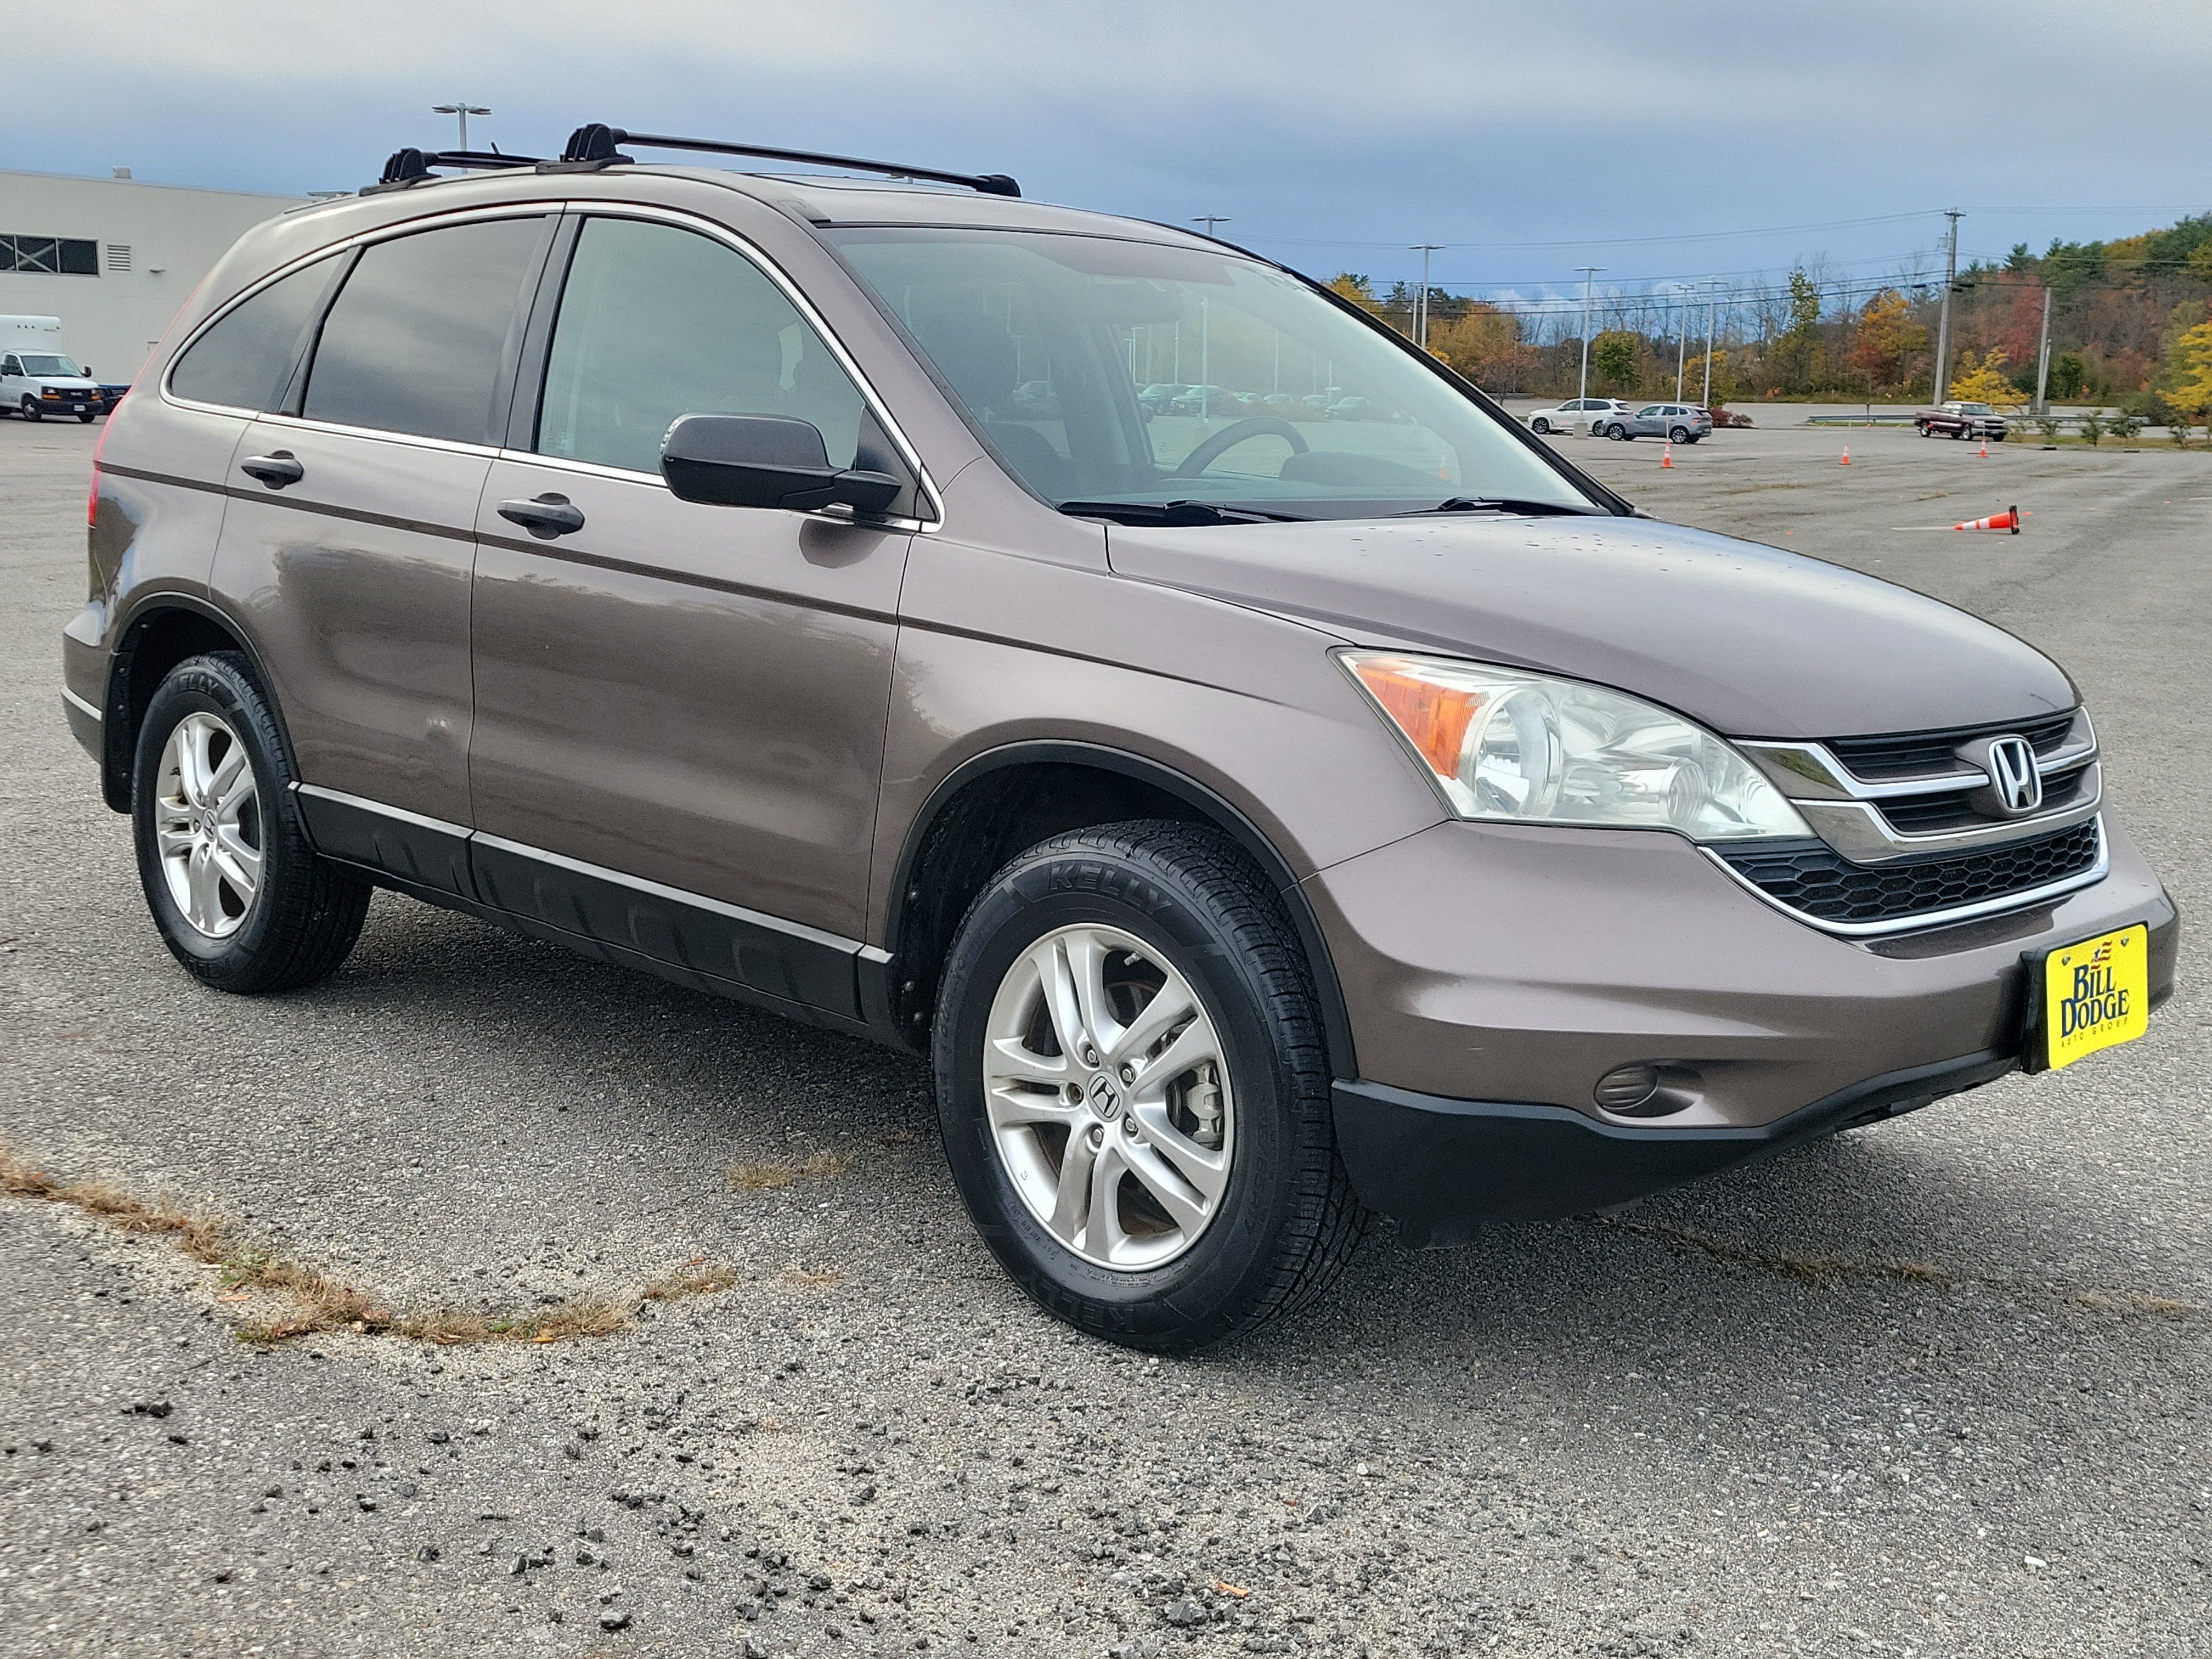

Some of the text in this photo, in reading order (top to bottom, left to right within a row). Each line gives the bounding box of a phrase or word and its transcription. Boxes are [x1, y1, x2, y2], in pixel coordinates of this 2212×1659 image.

[1048, 864, 1172, 911] KELLY
[2074, 964, 2116, 1003] BILL
[2061, 989, 2130, 1038] DODGE
[2092, 1017, 2128, 1035] GROUP
